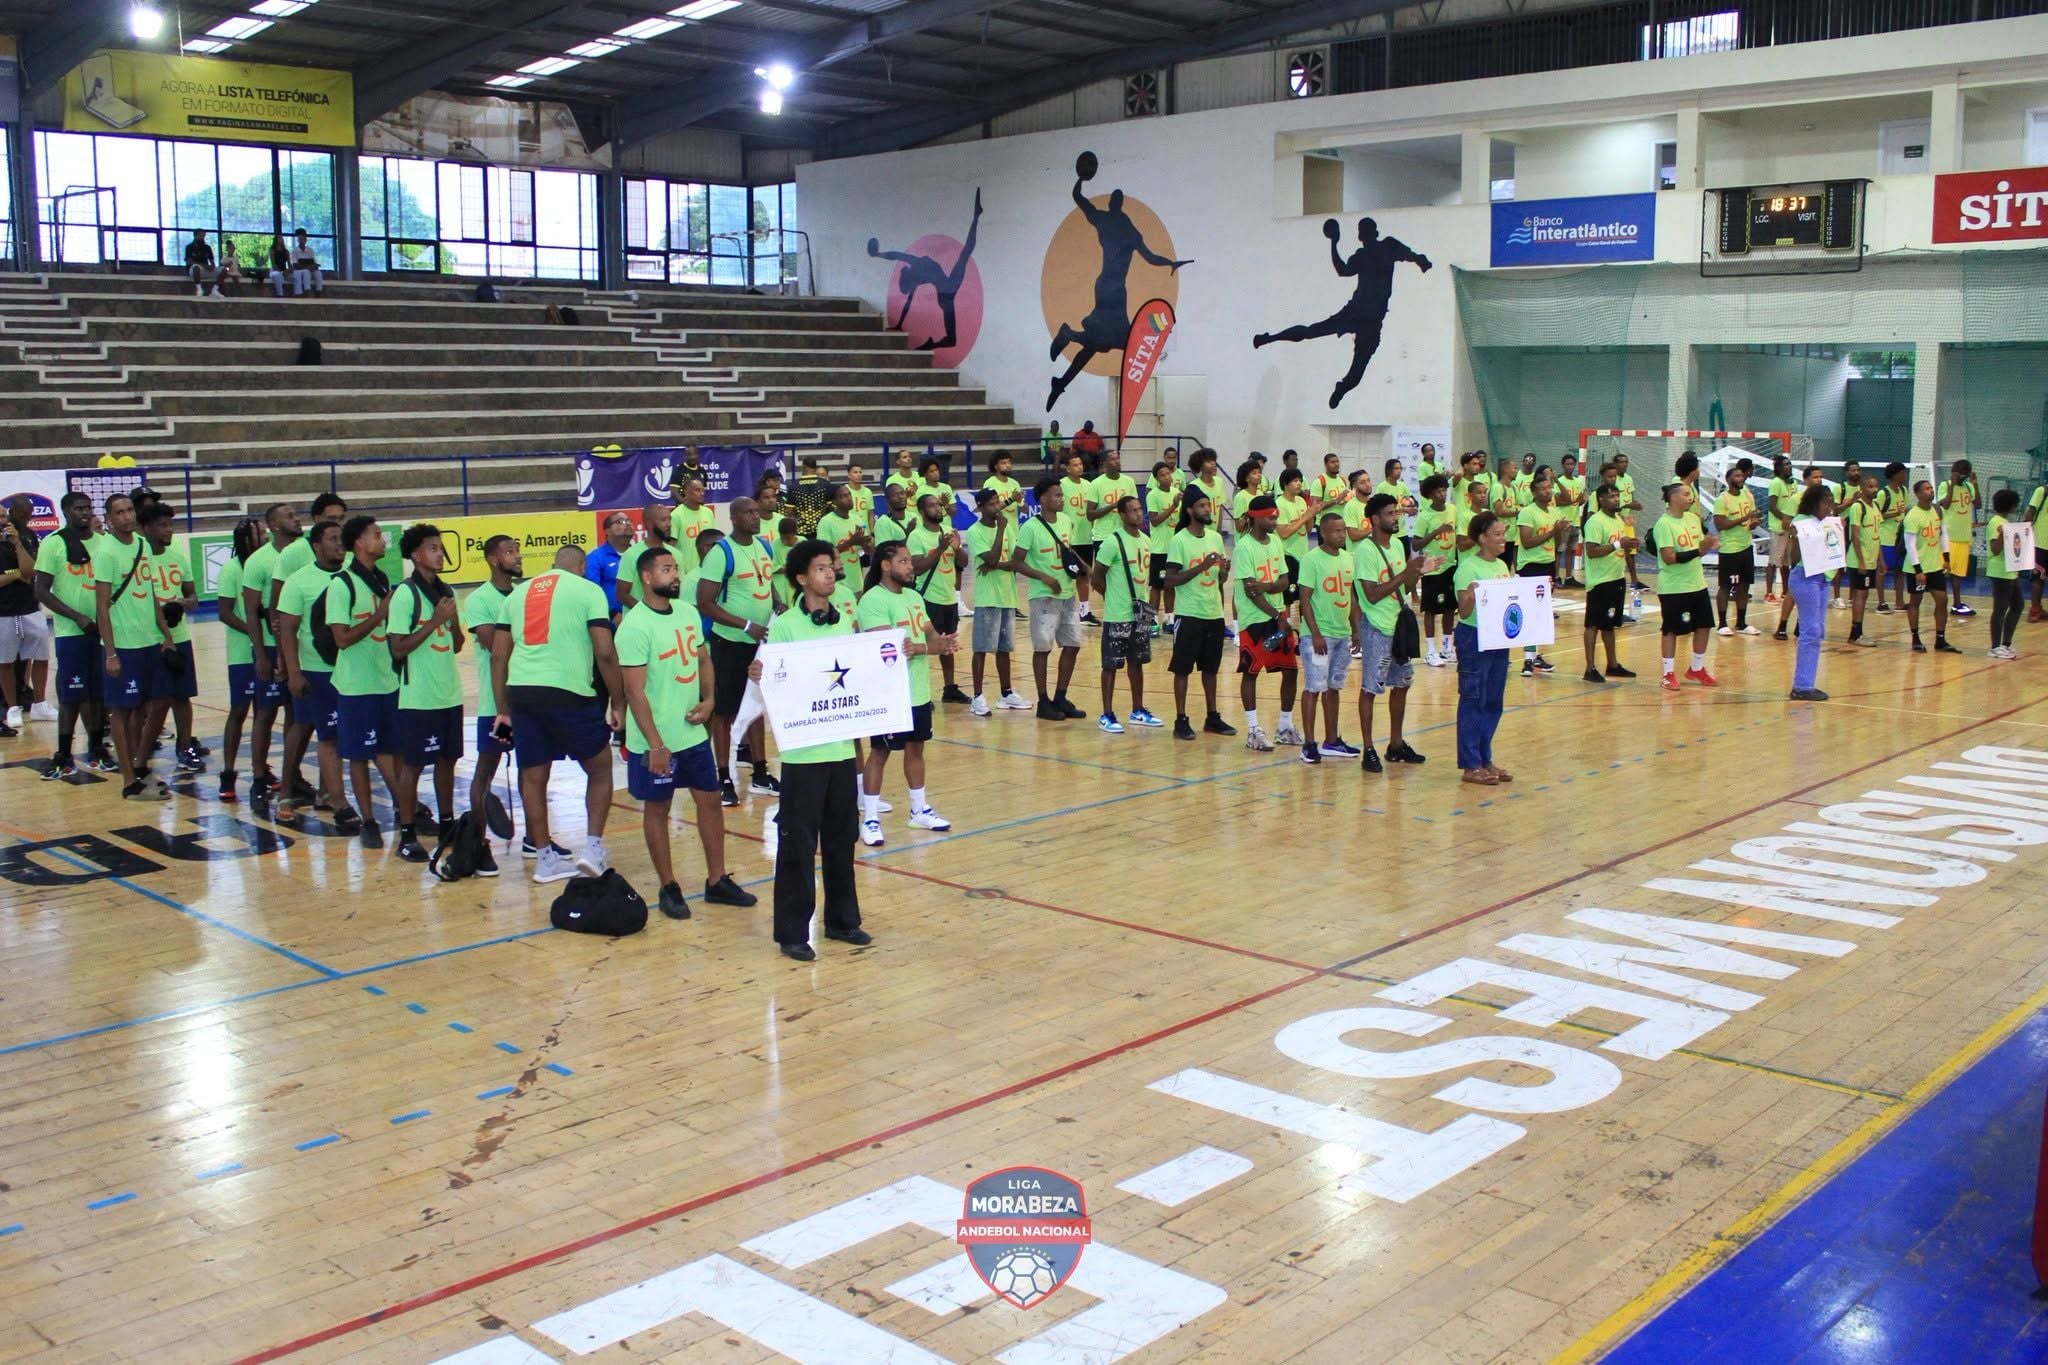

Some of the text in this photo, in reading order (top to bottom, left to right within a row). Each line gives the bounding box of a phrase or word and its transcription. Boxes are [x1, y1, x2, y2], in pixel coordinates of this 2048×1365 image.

[160, 80, 330, 106] AGORA A LISTA TELEFÓNICA
[182, 97, 312, 120] EM FORMATO DIGITAL
[1533, 216, 1563, 227] Banco
[1533, 222, 1638, 241] Interatlântico
[525, 531, 587, 548] Amarelas
[811, 694, 860, 713] ASA STARS
[783, 707, 888, 730] CAMPEÃO NACIONAL 2024/2025
